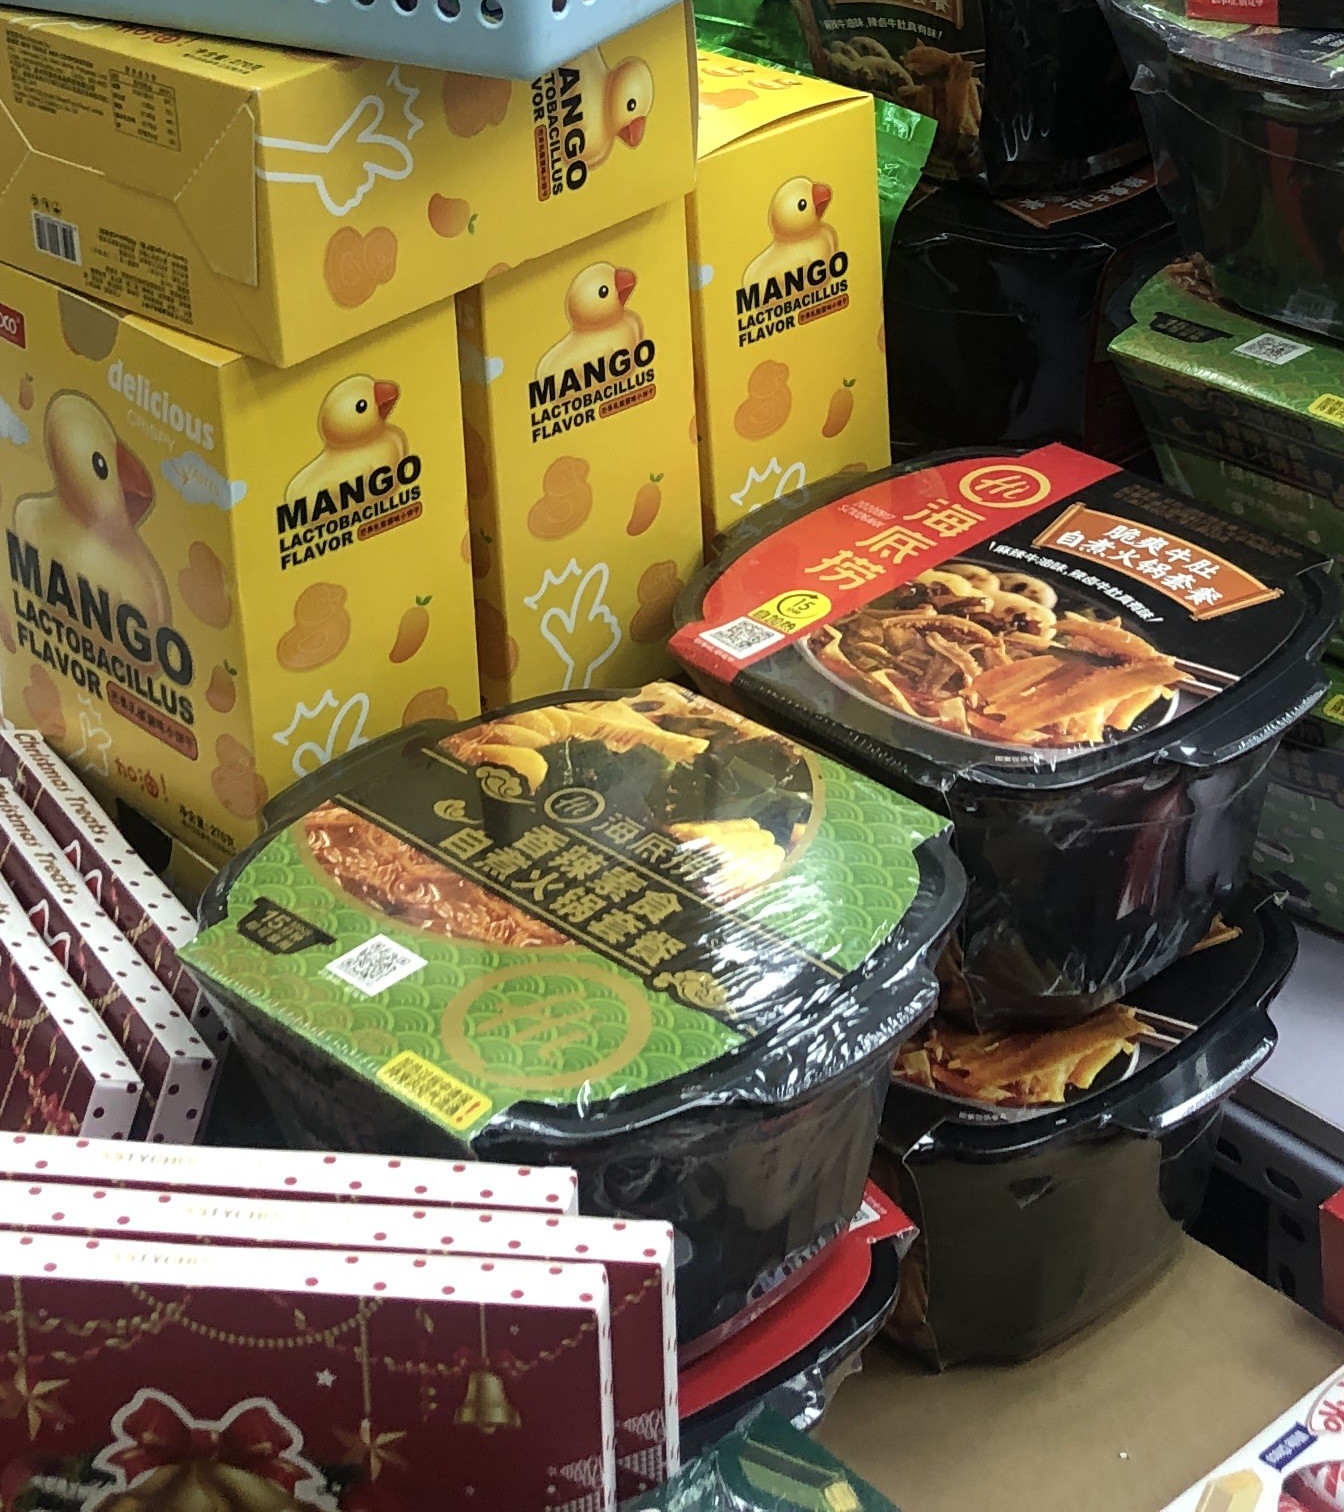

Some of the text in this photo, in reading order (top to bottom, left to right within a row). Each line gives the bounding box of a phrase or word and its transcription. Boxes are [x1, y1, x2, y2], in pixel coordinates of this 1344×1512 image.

[542, 71, 564, 196] TOBACILLUS
[558, 65, 589, 192] ANGO
[735, 251, 849, 315] MANGO
[737, 279, 849, 332] LACTOBACILLUS
[738, 316, 796, 348] FLAVOR
[108, 359, 215, 452] delicious
[528, 338, 656, 409] MANGO
[530, 368, 655, 427] LACTOBACILLUS
[531, 407, 596, 444] FLAVOR
[276, 453, 423, 534] MANGO
[278, 483, 423, 554] LACTOBACILLUS
[280, 530, 355, 571] FLAVOR
[804, 498, 985, 592] 海底捞
[1056, 530, 1224, 607] 自煮火锅套餐
[1102, 524, 1220, 580] 脆爽牛肚
[6, 530, 196, 688] MANGO
[12, 593, 196, 727] LACTOBACILLUS
[17, 621, 104, 701] FLAVOR
[14, 731, 108, 838] Christmas Treats
[33, 849, 77, 897] Treats
[438, 828, 687, 968] 自煮火锅套餐
[512, 826, 684, 926] 香辣素食
